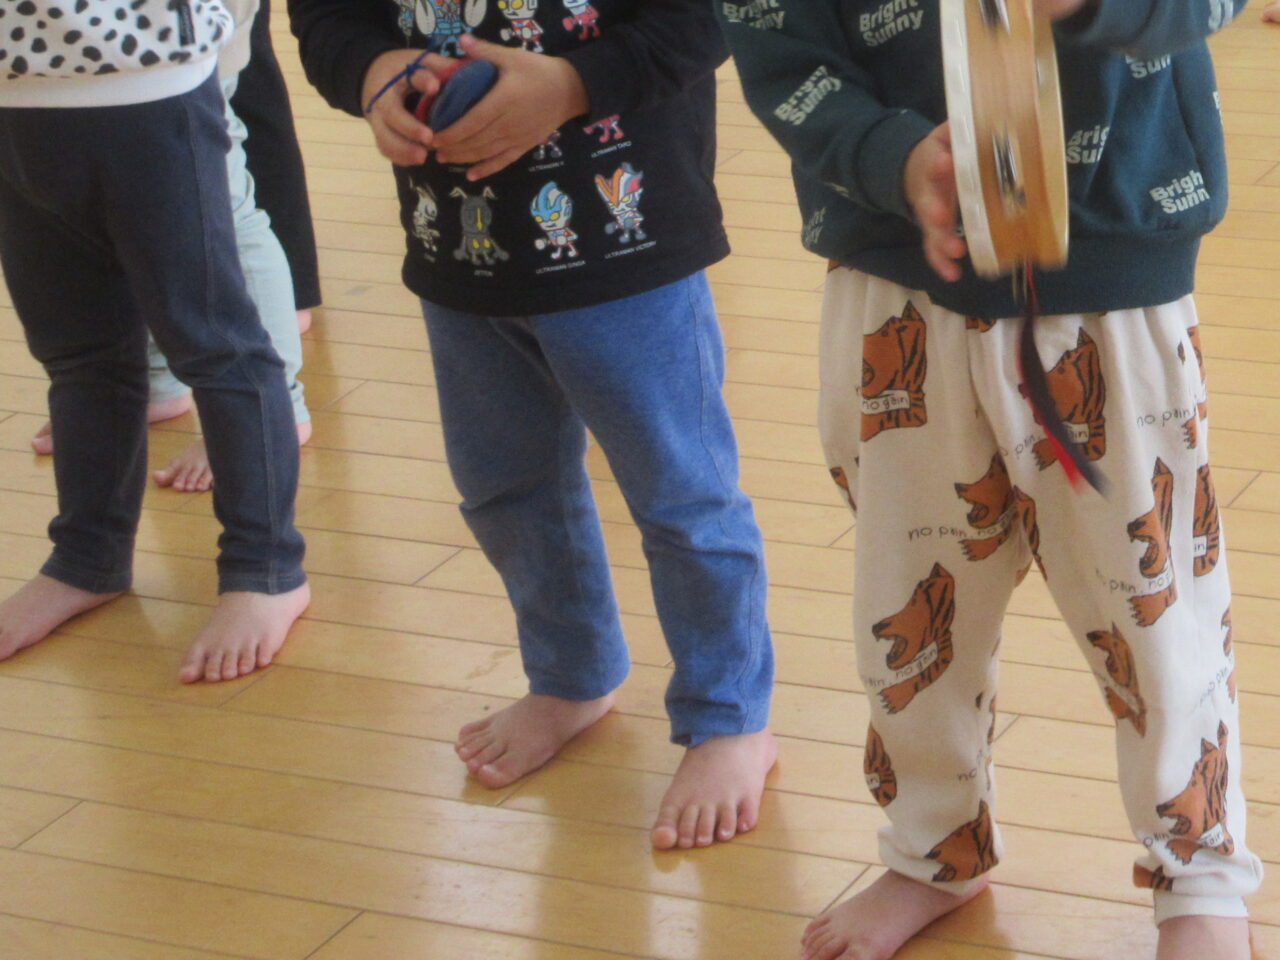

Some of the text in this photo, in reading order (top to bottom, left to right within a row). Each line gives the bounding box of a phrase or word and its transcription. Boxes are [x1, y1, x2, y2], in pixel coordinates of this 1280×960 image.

[862, 10, 924, 47] Sunny
[1137, 414, 1156, 428] no
[908, 525, 934, 541] no
